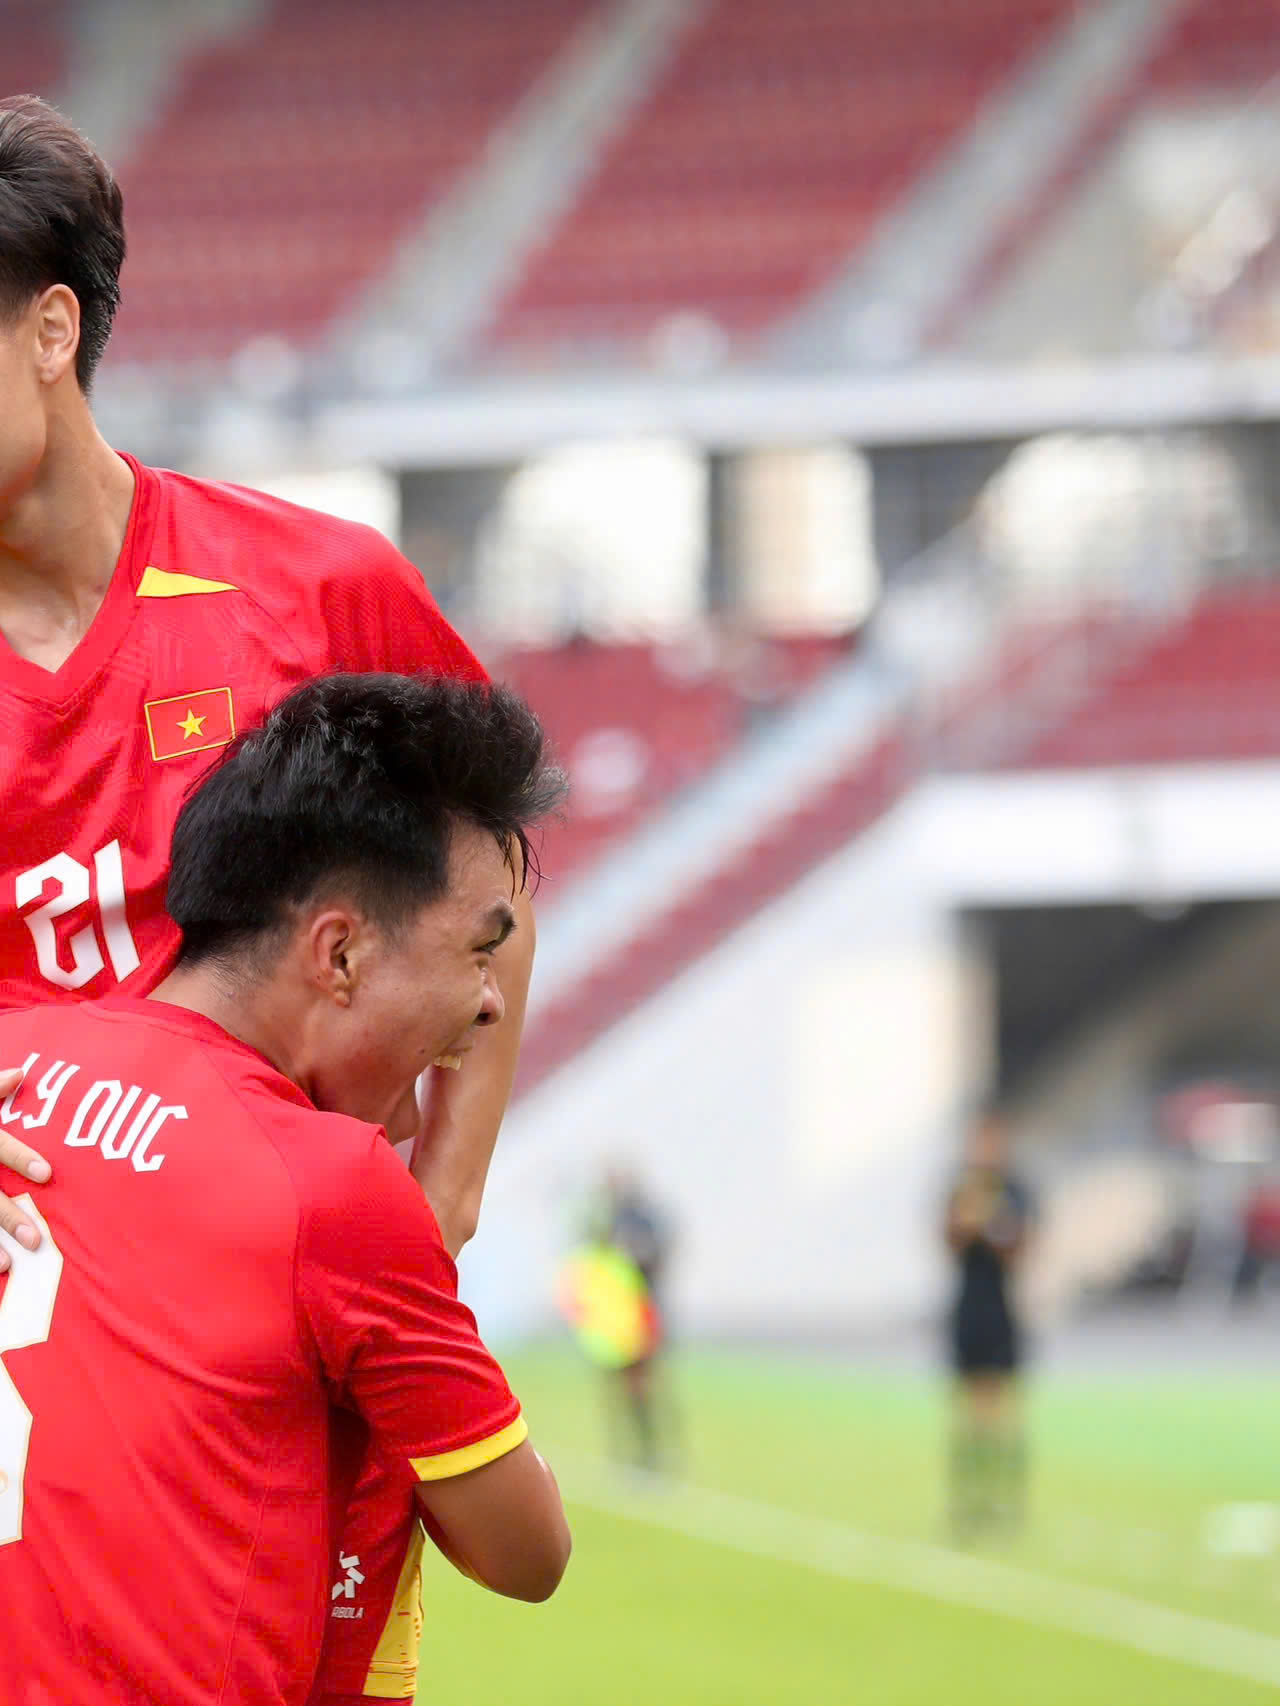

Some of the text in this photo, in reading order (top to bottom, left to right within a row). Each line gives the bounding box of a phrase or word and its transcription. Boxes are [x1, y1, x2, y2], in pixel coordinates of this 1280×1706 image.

[15, 837, 142, 991] 21
[0, 1052, 81, 1130] LY
[63, 1079, 189, 1173] DUC
